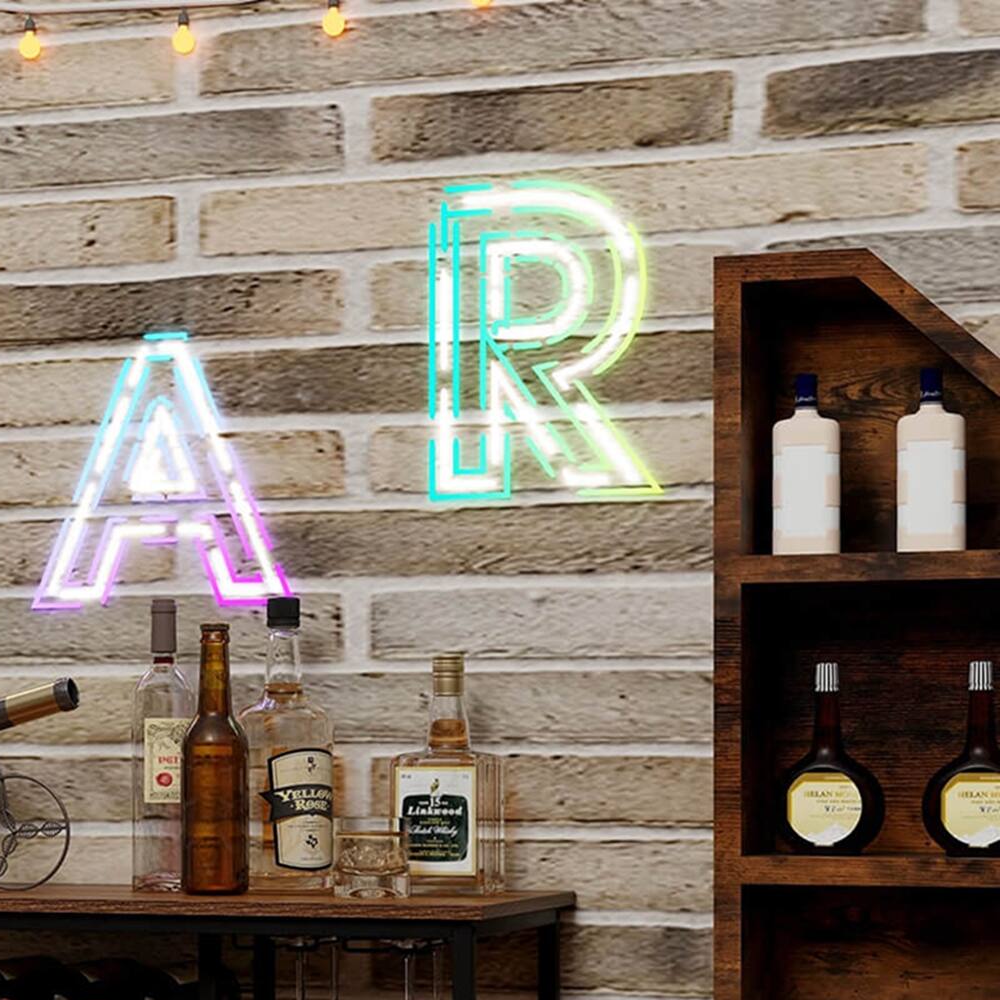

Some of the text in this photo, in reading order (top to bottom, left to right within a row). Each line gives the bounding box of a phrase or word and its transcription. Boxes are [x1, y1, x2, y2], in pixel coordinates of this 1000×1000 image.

[274, 788, 332, 802] YELLOW
[294, 799, 328, 811] ROSE
[407, 806, 463, 816] Linkwood
